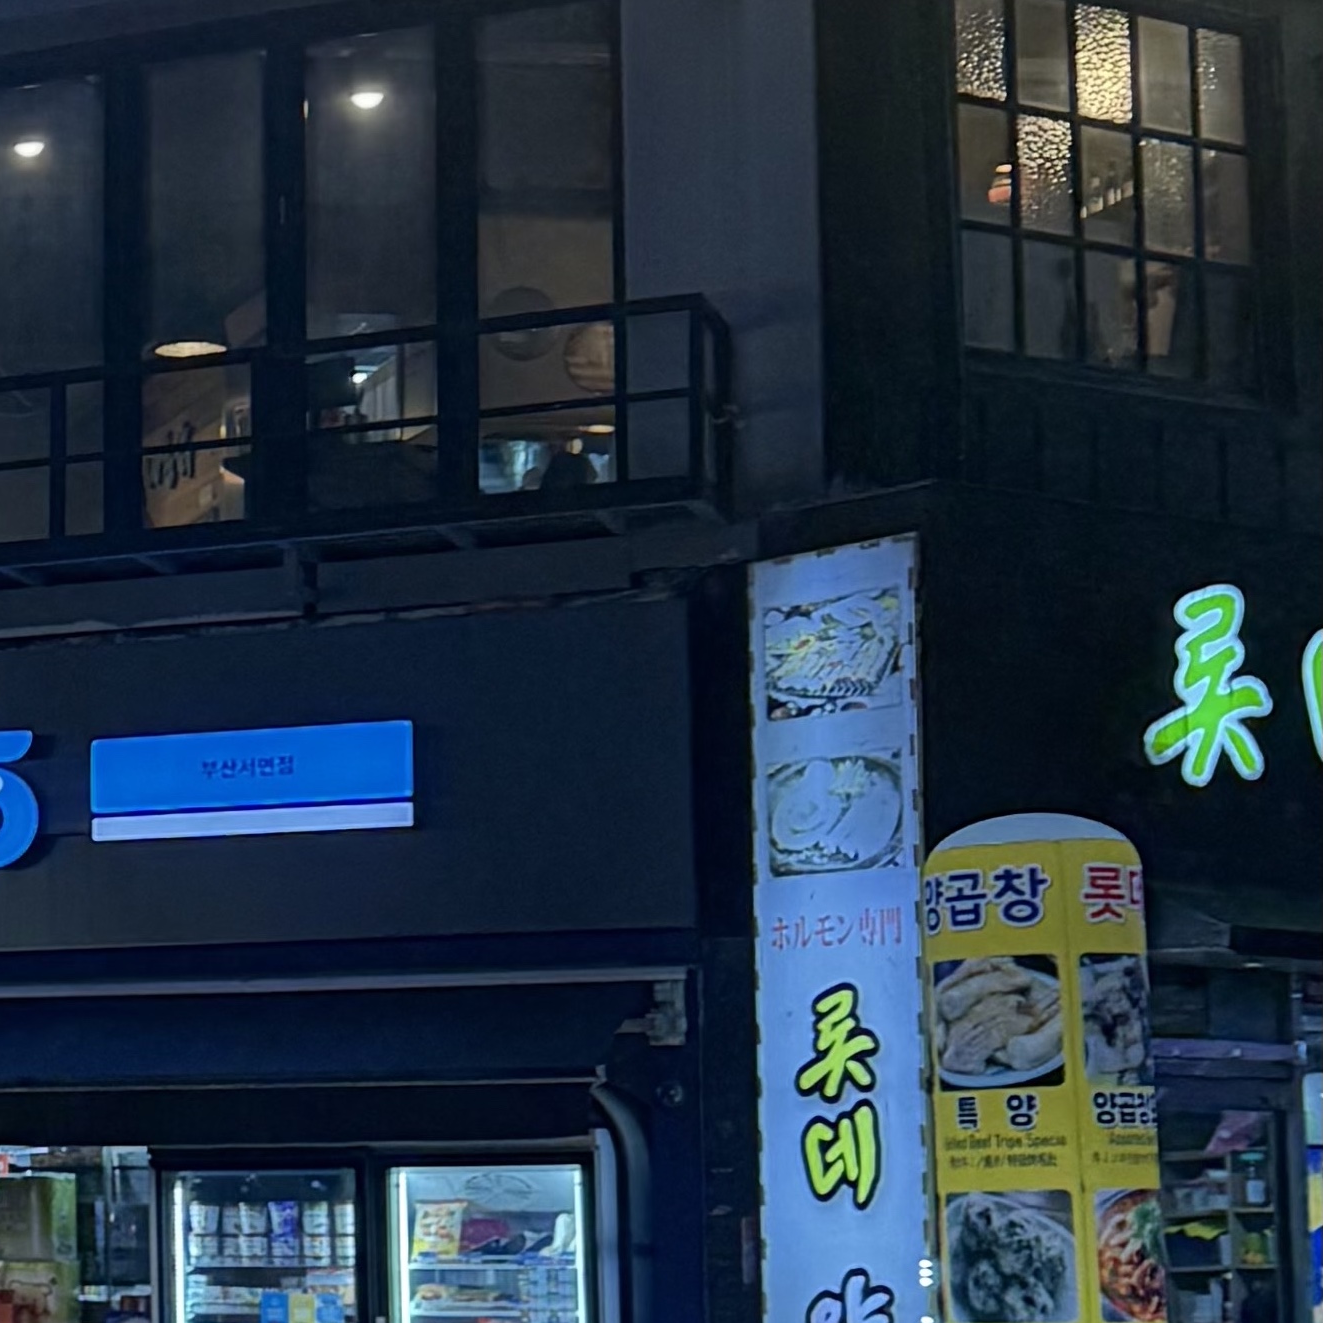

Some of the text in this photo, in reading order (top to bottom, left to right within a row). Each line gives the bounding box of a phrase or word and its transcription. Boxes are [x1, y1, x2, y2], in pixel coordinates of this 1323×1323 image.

[200, 755, 295, 780] 부산서면점
[923, 863, 1051, 936] 양곱창
[795, 978, 880, 1211] 롯데
